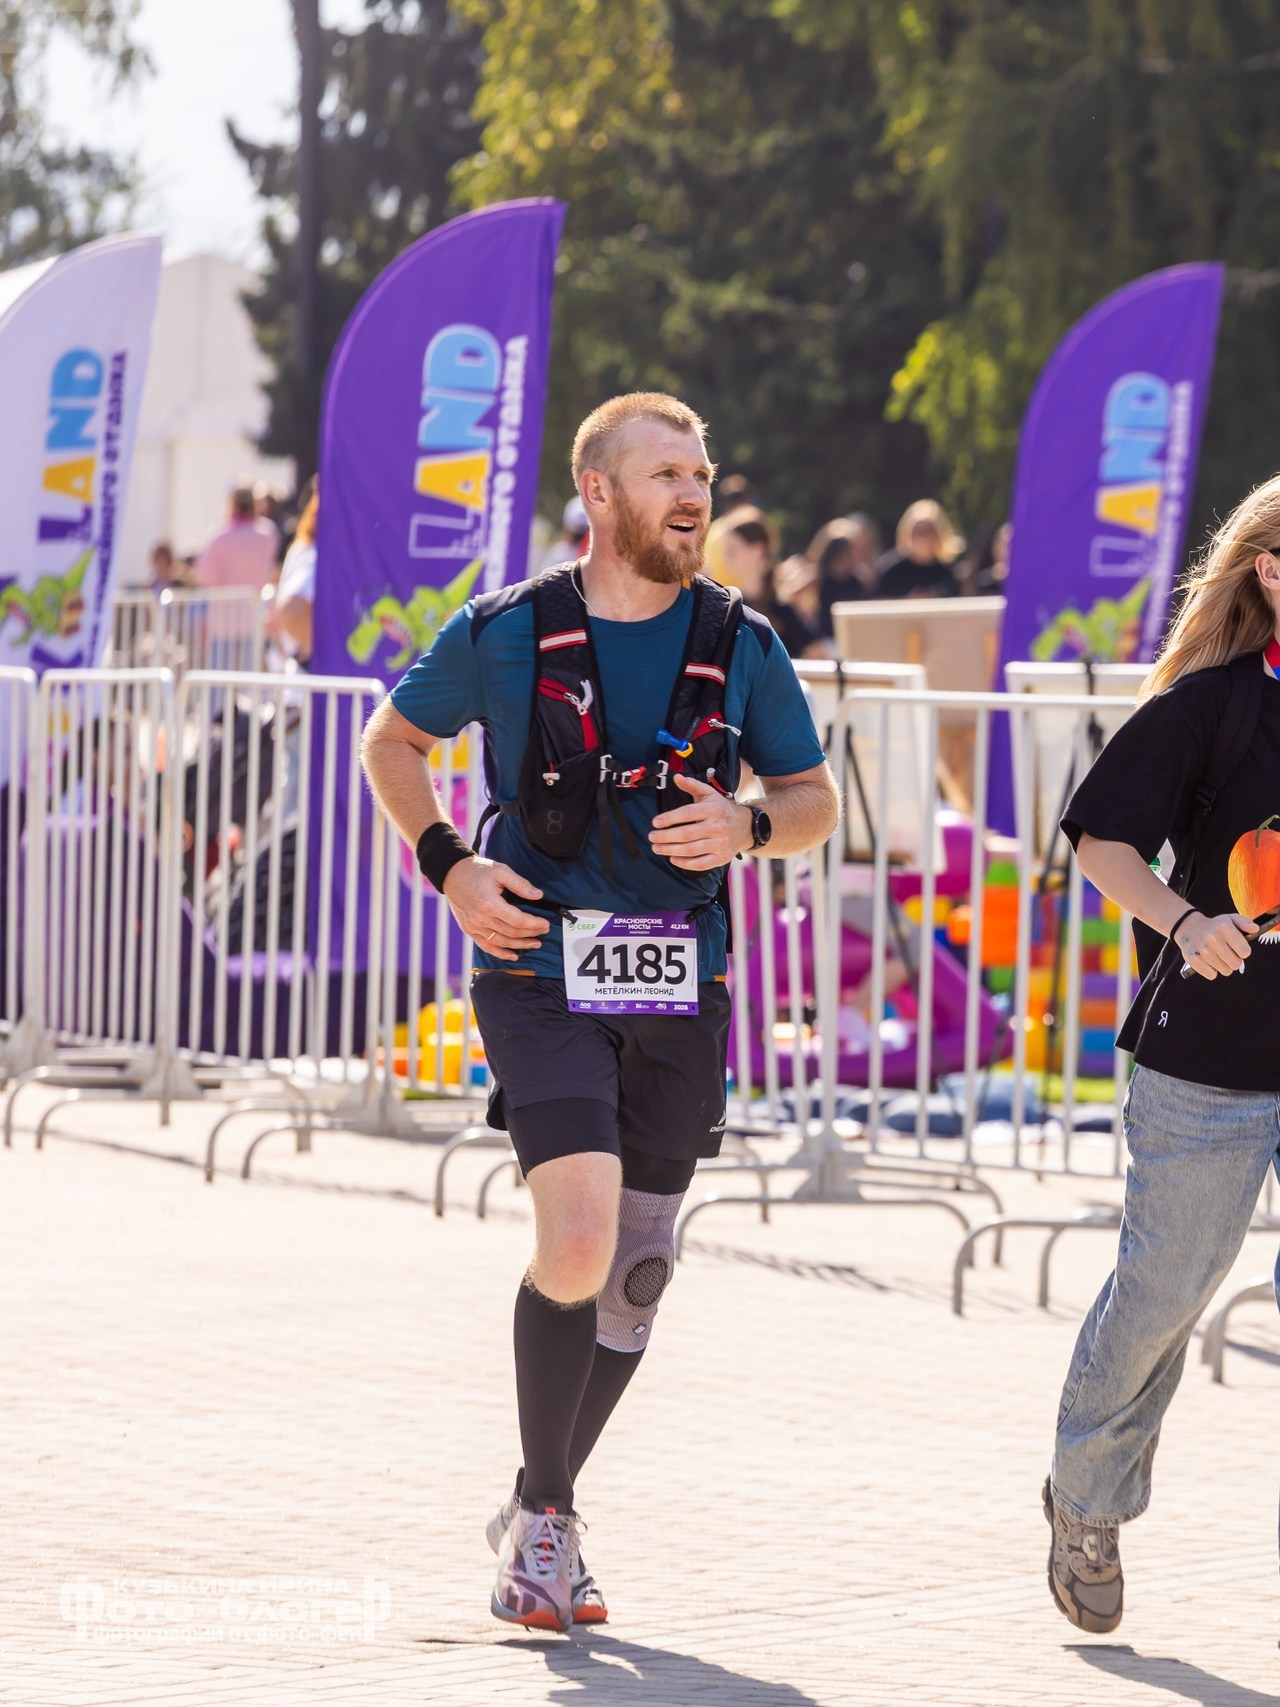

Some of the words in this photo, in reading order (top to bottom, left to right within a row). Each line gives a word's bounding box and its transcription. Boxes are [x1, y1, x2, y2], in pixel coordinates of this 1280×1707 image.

[37, 350, 104, 545] LAND
[409, 324, 501, 559] LAND
[1089, 371, 1170, 577] LAND
[577, 943, 687, 985] 4185
[595, 986, 643, 995] МЕТЁЛКИН
[644, 987, 674, 996] ЛЕОНИД
